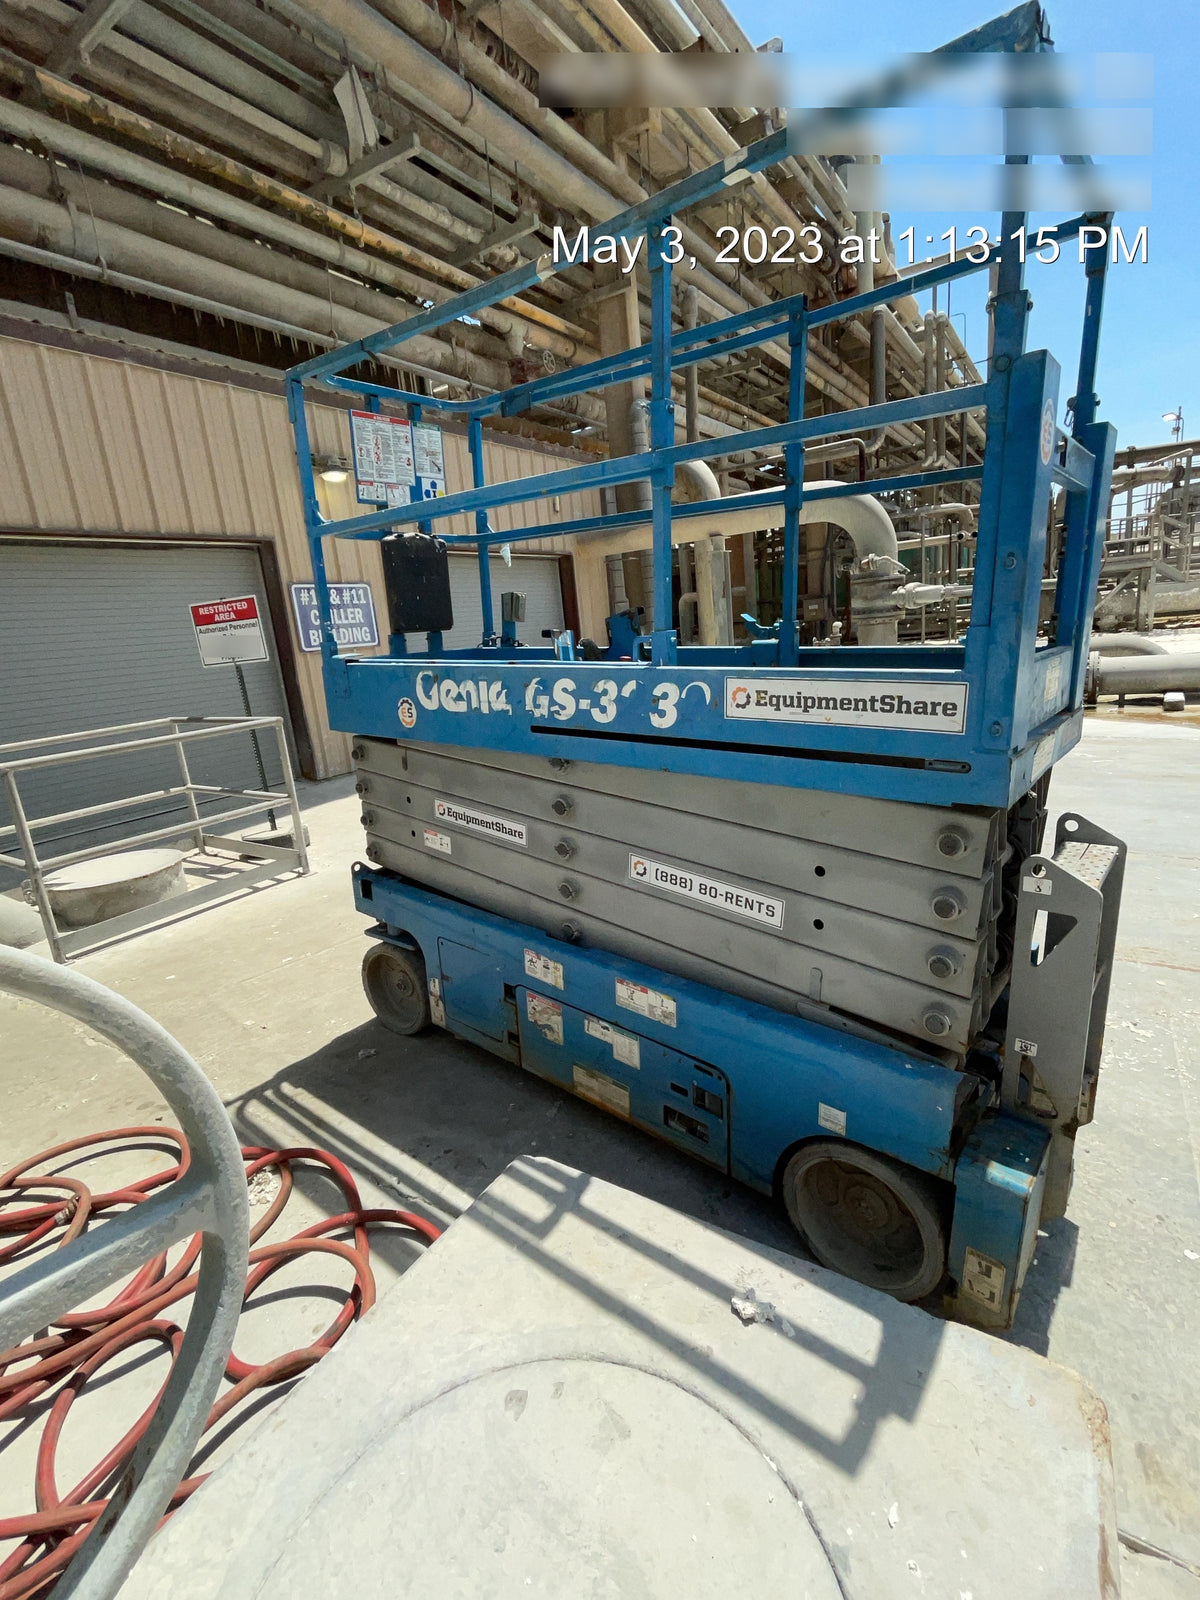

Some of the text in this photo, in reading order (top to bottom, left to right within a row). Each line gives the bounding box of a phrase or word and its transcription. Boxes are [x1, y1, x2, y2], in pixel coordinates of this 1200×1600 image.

[300, 588, 367, 606] #1 & #11
[198, 601, 248, 615] RESTRICTED
[214, 612, 236, 621] AREA
[310, 608, 364, 625] CILLER
[199, 621, 257, 634] Authorized Personnel
[309, 626, 371, 646] BLDING
[525, 677, 711, 728] GS-33
[755, 690, 958, 717] EquipmentShare
[401, 706, 413, 718] ES
[447, 807, 524, 839] EquipmentShare
[655, 868, 775, 918] (888) 80-RENTS
